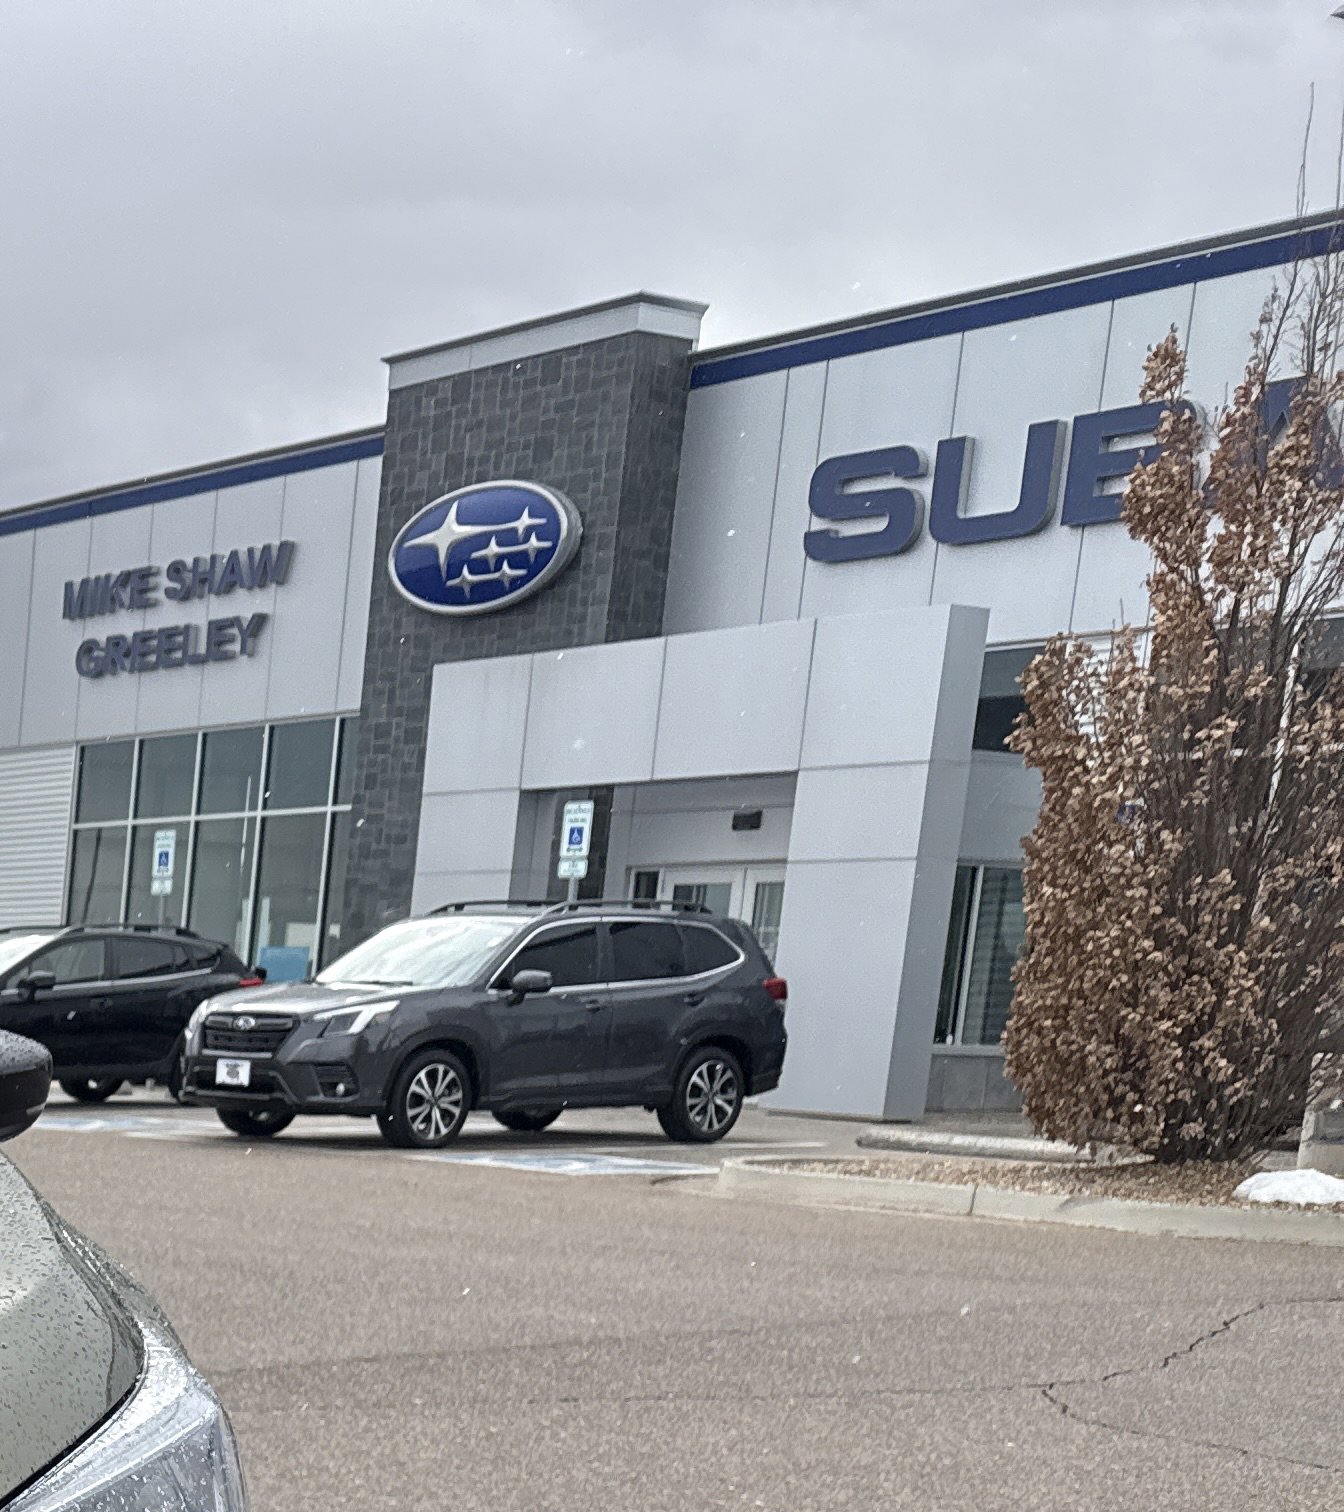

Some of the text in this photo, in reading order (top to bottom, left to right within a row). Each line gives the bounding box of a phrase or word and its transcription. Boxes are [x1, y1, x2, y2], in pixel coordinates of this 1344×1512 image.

[62, 540, 296, 620] MIKE SHAW
[75, 612, 269, 679] GREELEY
